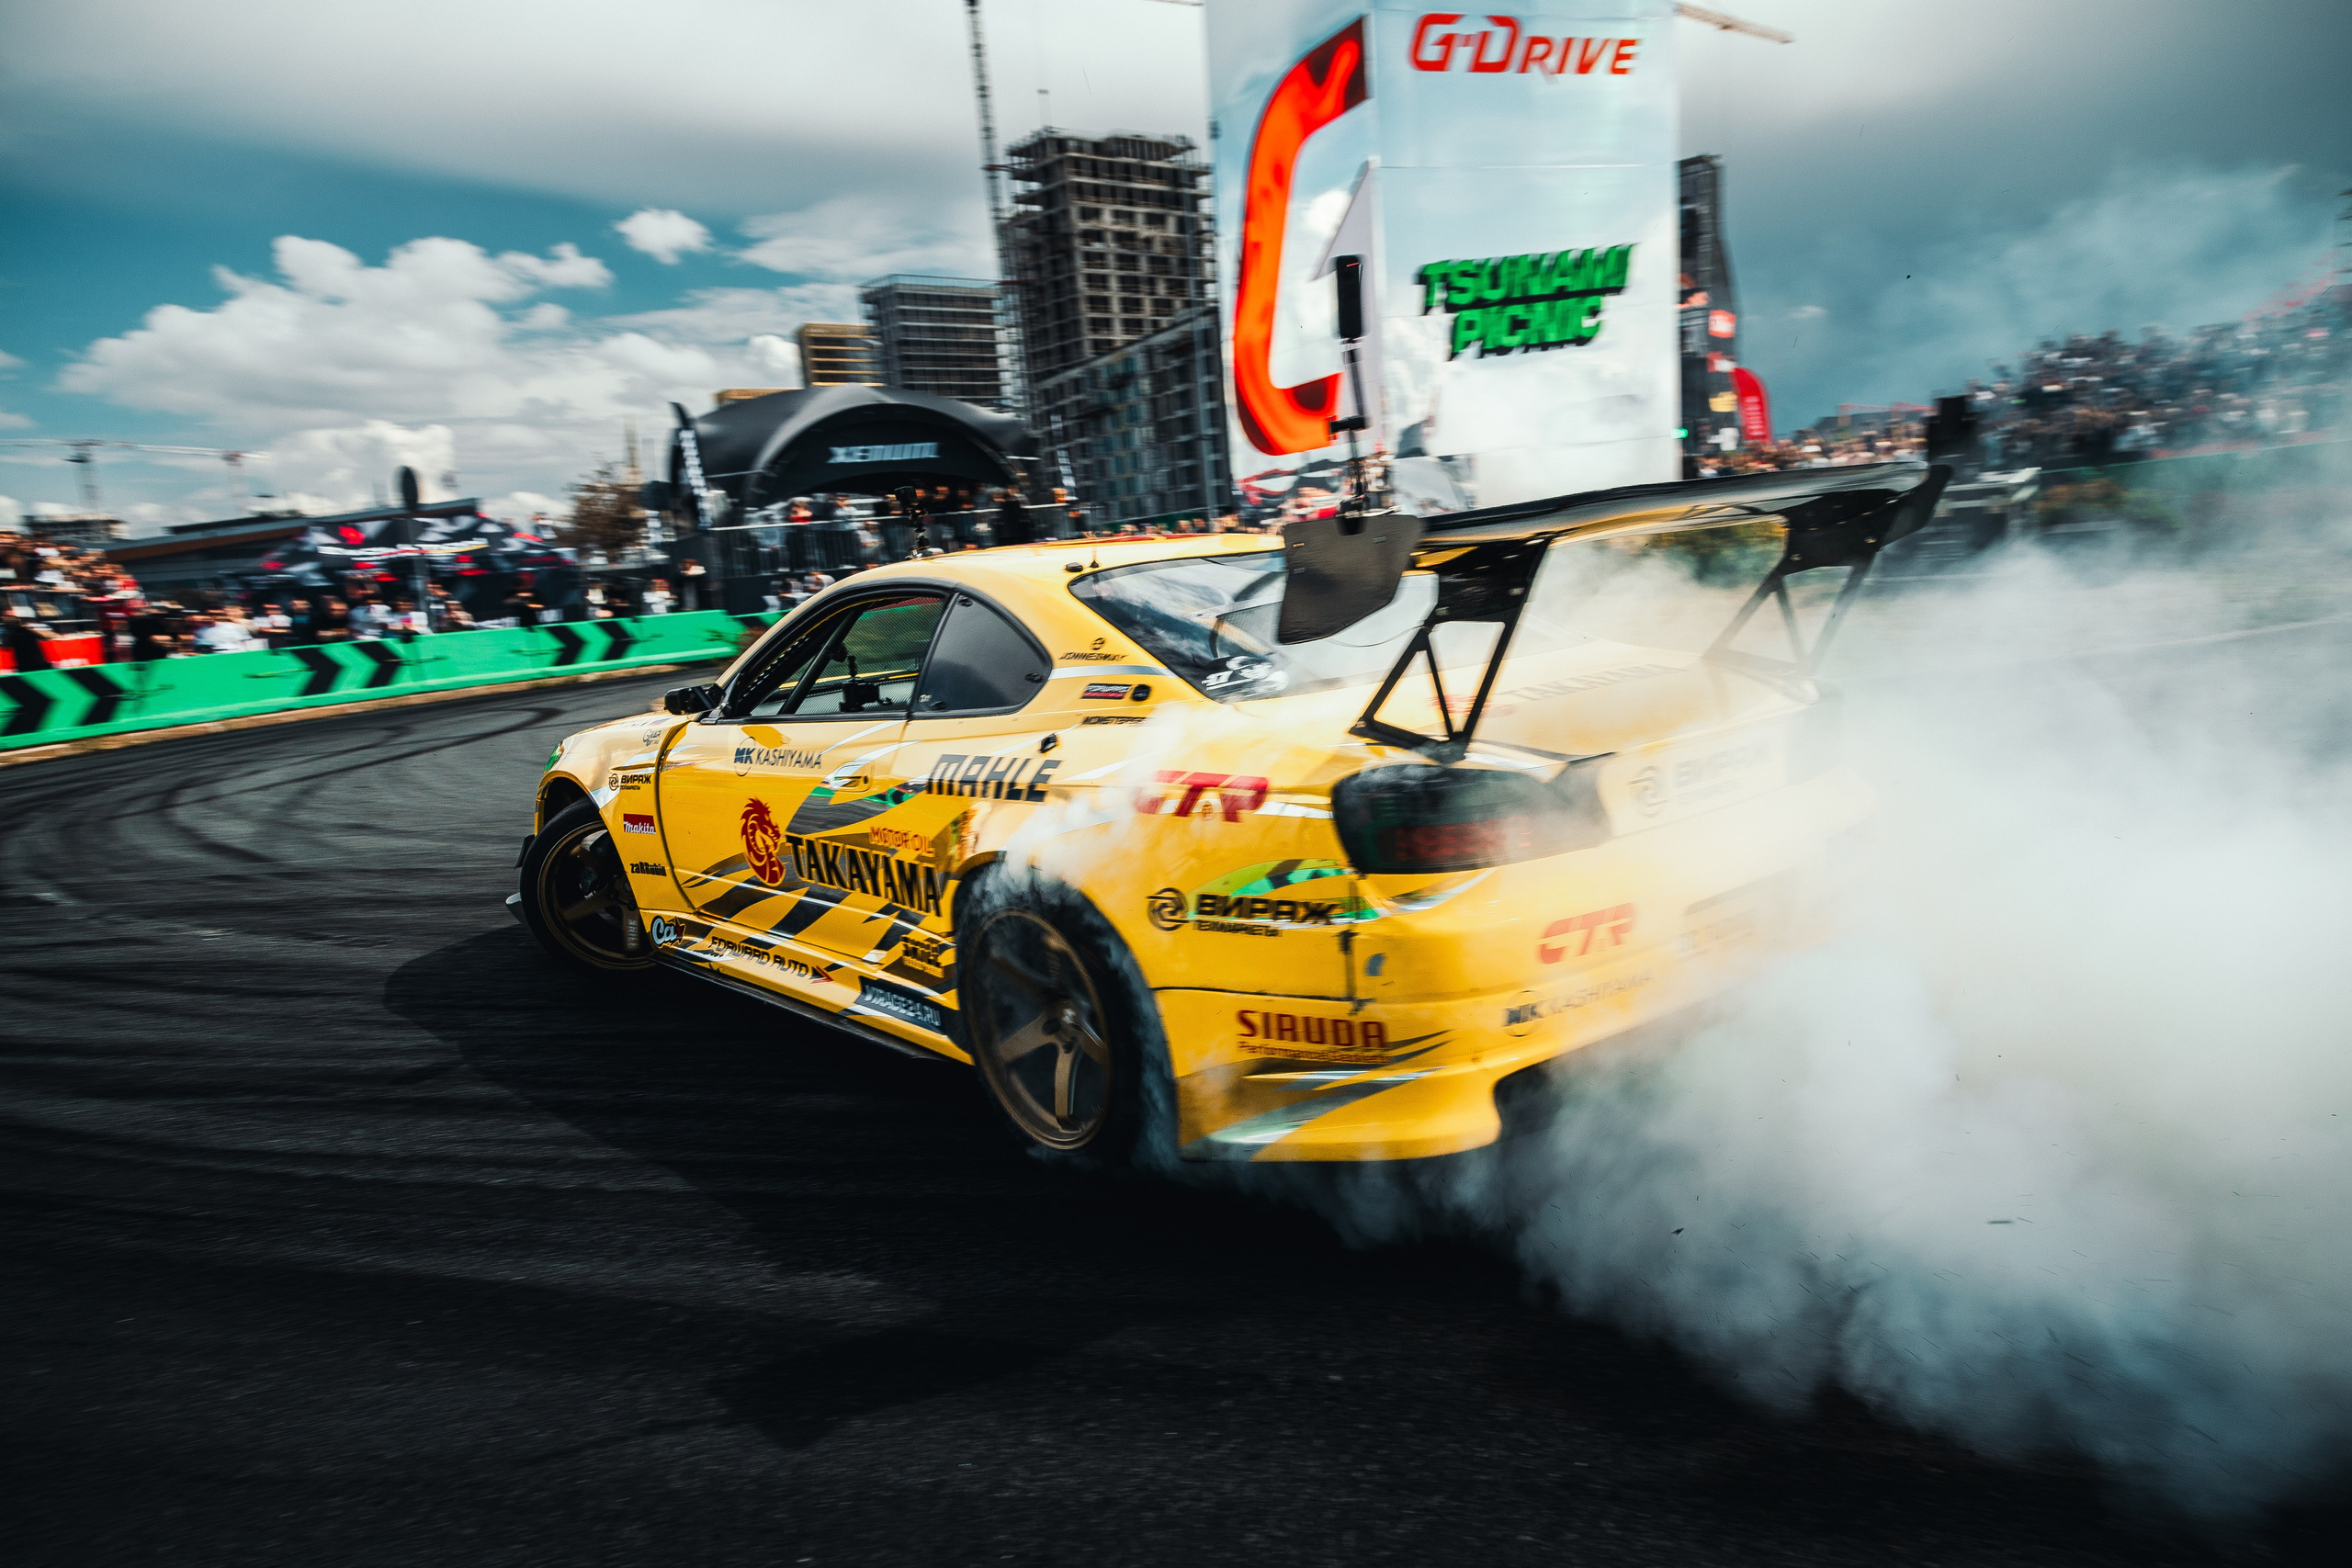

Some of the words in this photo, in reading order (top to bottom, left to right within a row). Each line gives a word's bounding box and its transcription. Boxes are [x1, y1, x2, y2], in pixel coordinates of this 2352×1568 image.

[1417, 244, 1636, 311] TSUNAMI
[1448, 295, 1604, 359] PICNIC
[620, 774, 651, 784] ВИРАЖ
[755, 748, 822, 770] KASHIYAMA
[927, 753, 1061, 803] MAHLE
[1132, 770, 1269, 823] CTR
[870, 827, 910, 851] MOTOR
[910, 835, 935, 857] OIL
[786, 834, 942, 917] TAKAYAMA
[1196, 894, 1338, 925] ВИРАЖ
[1536, 902, 1637, 964] CTR
[708, 936, 770, 965] FORWARD
[773, 954, 808, 977] AUTO
[1238, 1010, 1388, 1048] SIRUDA
